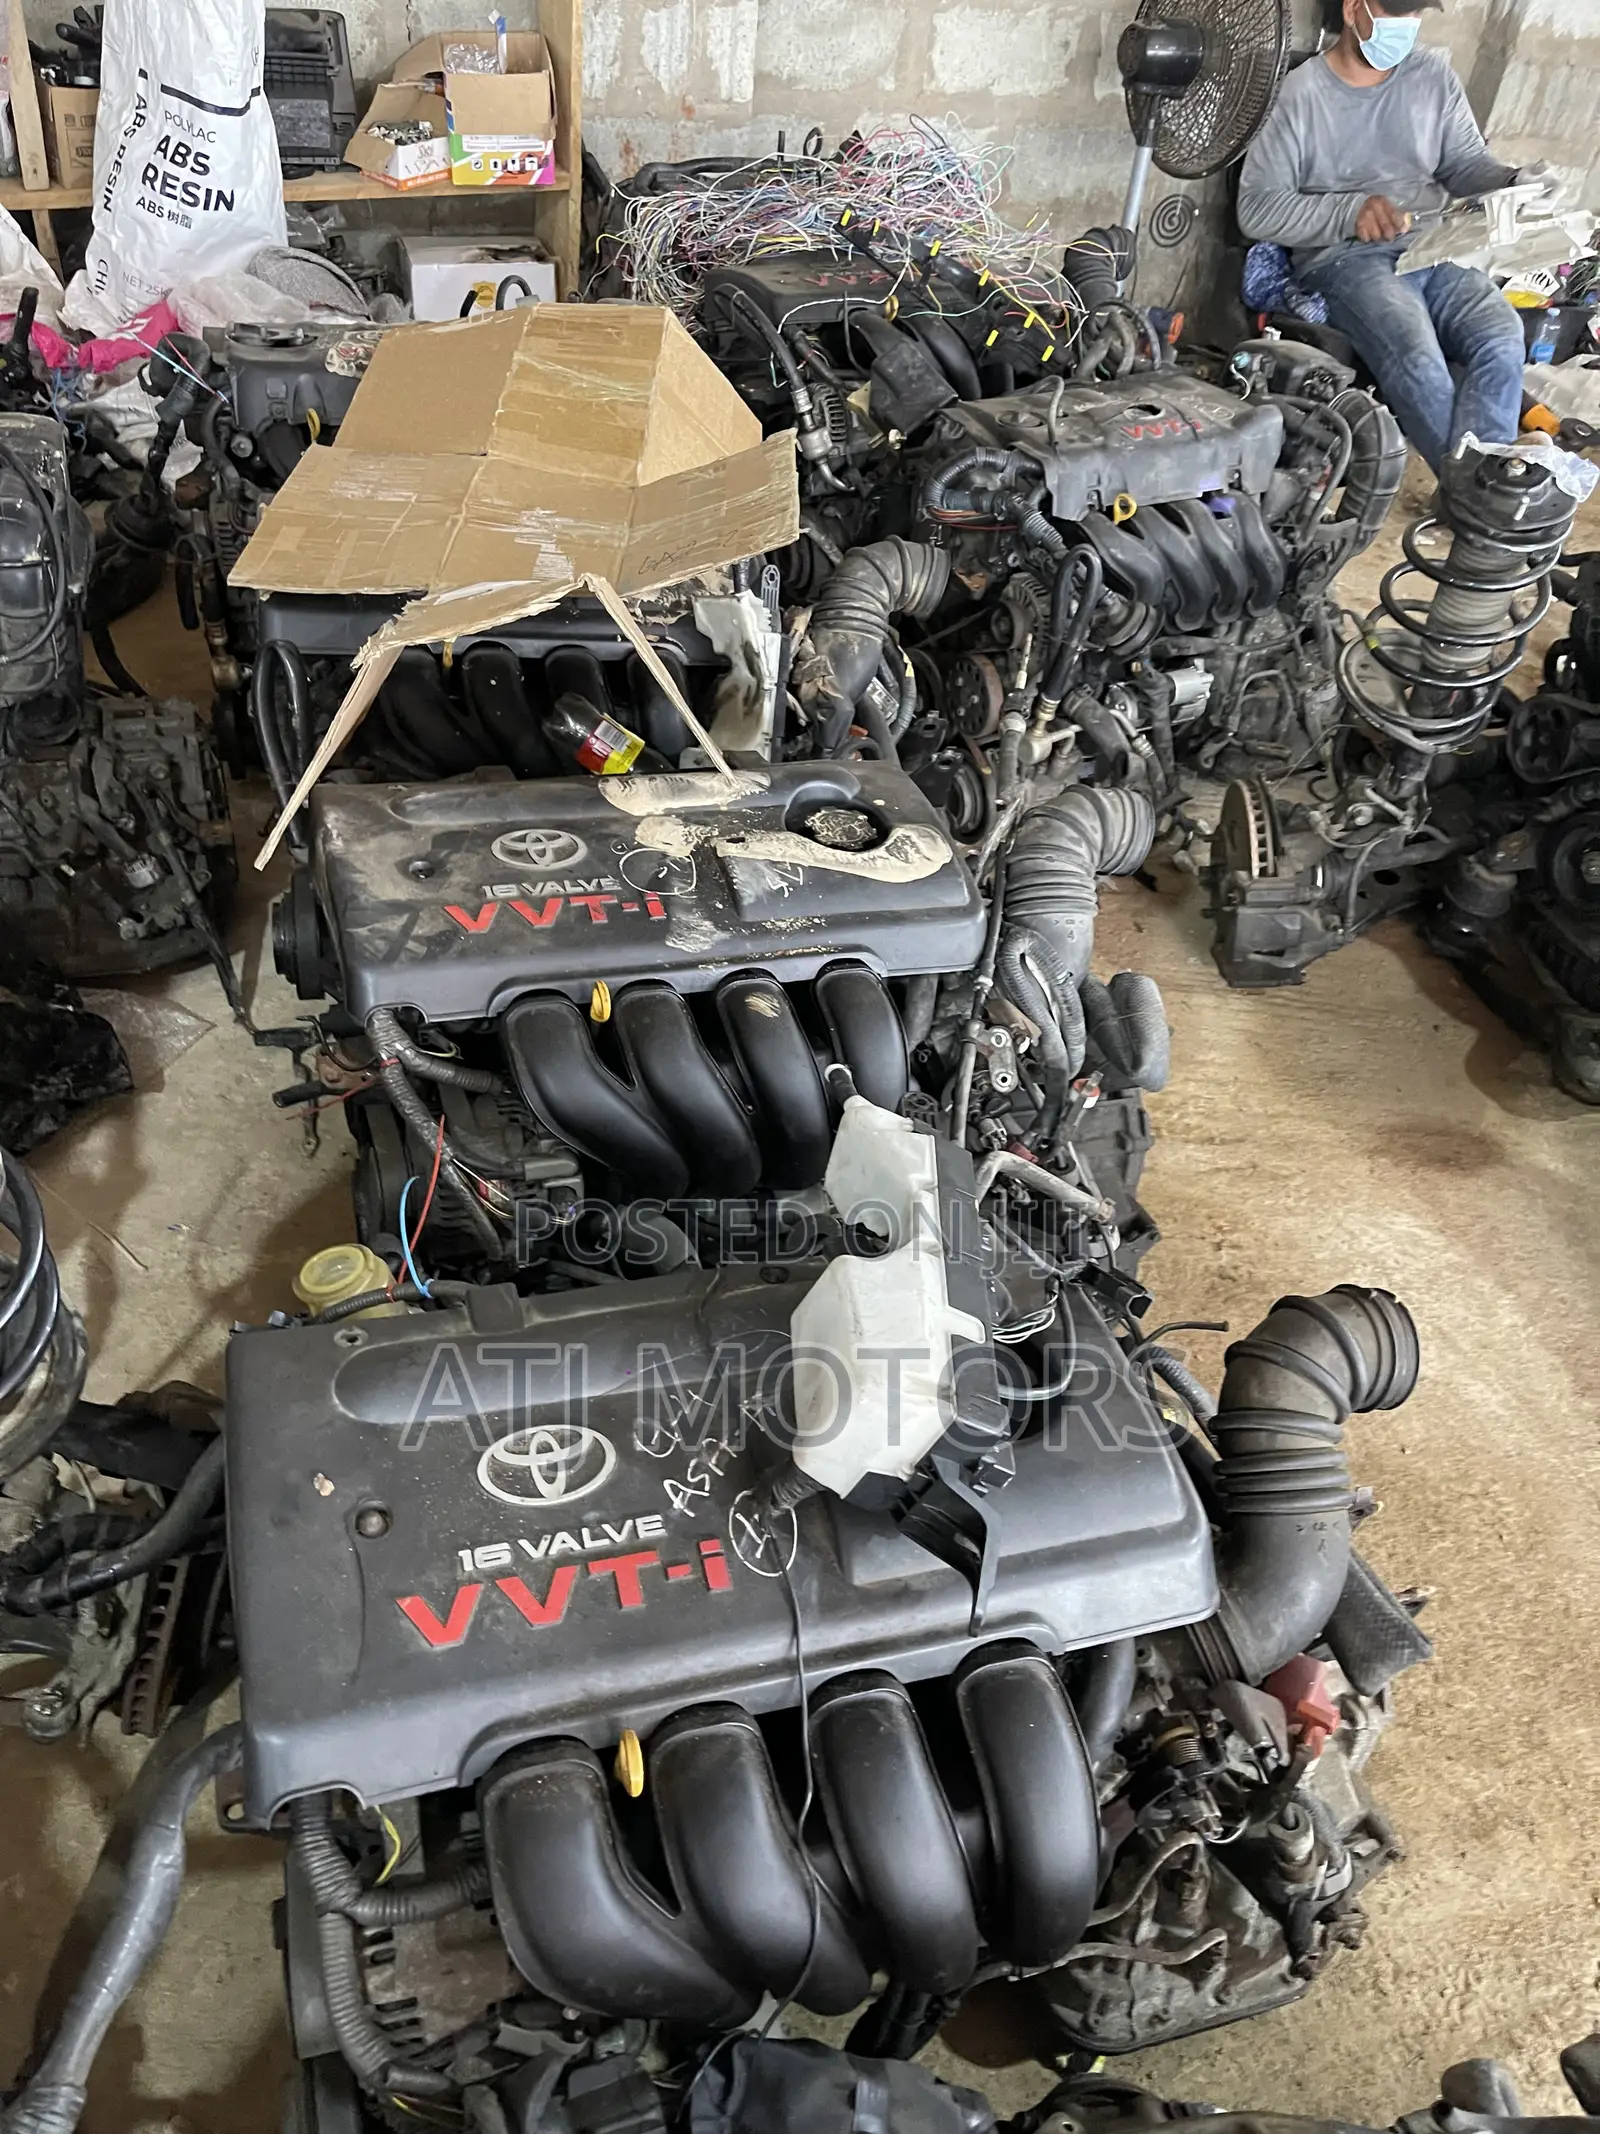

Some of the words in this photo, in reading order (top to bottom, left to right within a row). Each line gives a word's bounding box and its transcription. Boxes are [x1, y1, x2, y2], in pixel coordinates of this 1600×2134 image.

[123, 92, 148, 139] ABS
[164, 109, 217, 144] POLYLAC
[153, 134, 211, 176] ABS
[103, 144, 127, 213] RESIN
[141, 161, 236, 212] RESIN
[135, 196, 165, 219] ABS
[122, 271, 143, 290] NET
[517, 877, 622, 897] VALVE
[444, 892, 667, 934] VVT-i
[457, 1543, 513, 1572] 16
[517, 1513, 668, 1560] VALVE
[396, 1537, 734, 1651] VVT-i
